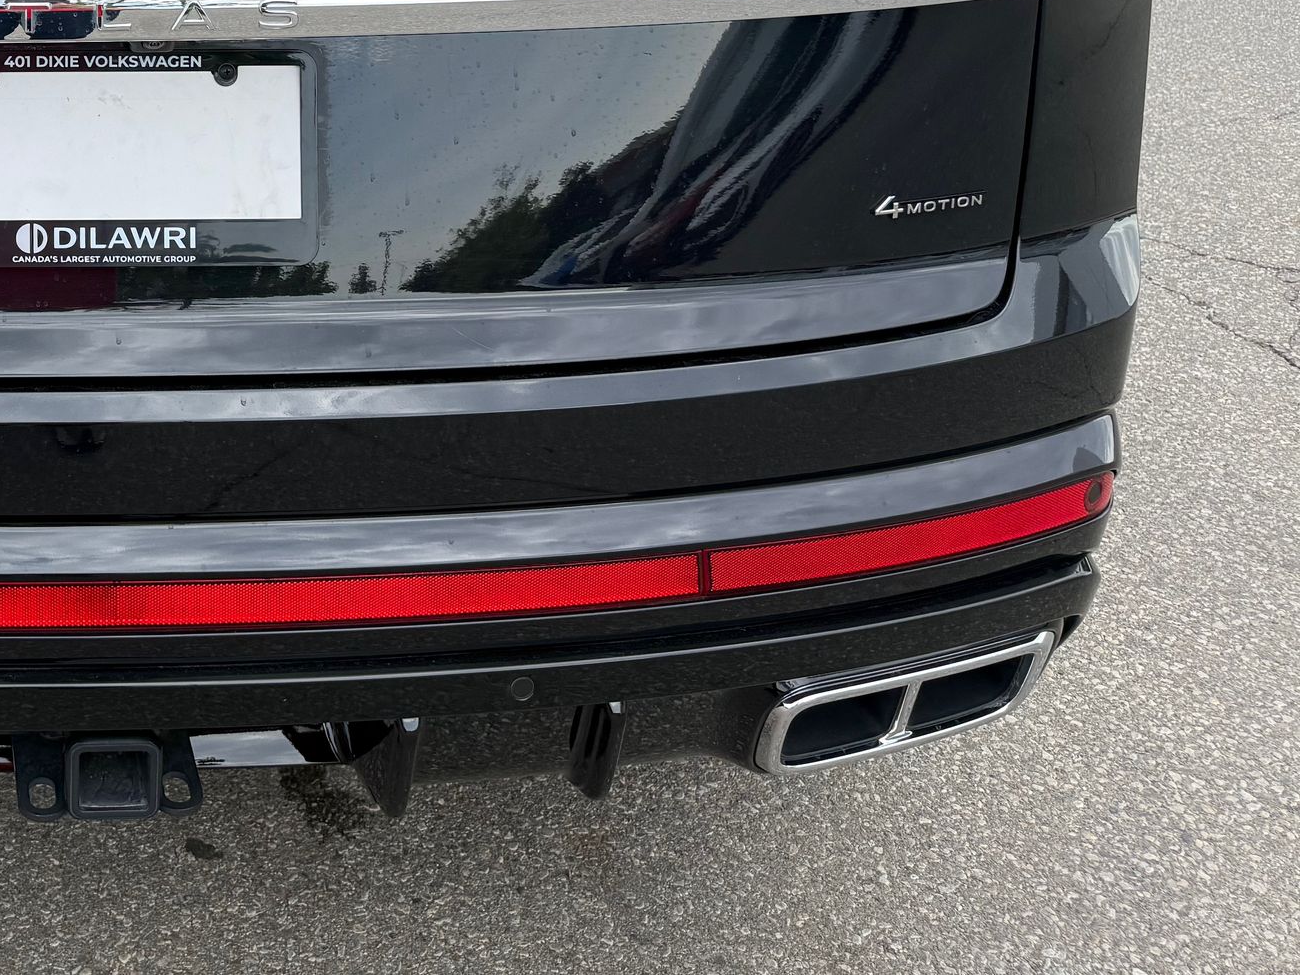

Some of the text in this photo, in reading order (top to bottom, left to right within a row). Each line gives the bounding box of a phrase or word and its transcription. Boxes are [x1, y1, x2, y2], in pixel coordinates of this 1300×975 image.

[4, 55, 202, 68] 401 DIXIE VOLKSWAGEN
[53, 227, 197, 249] DILAWRI
[12, 255, 196, 263] CANADA'S LARGEST AUTOMOTIVE GROUP
